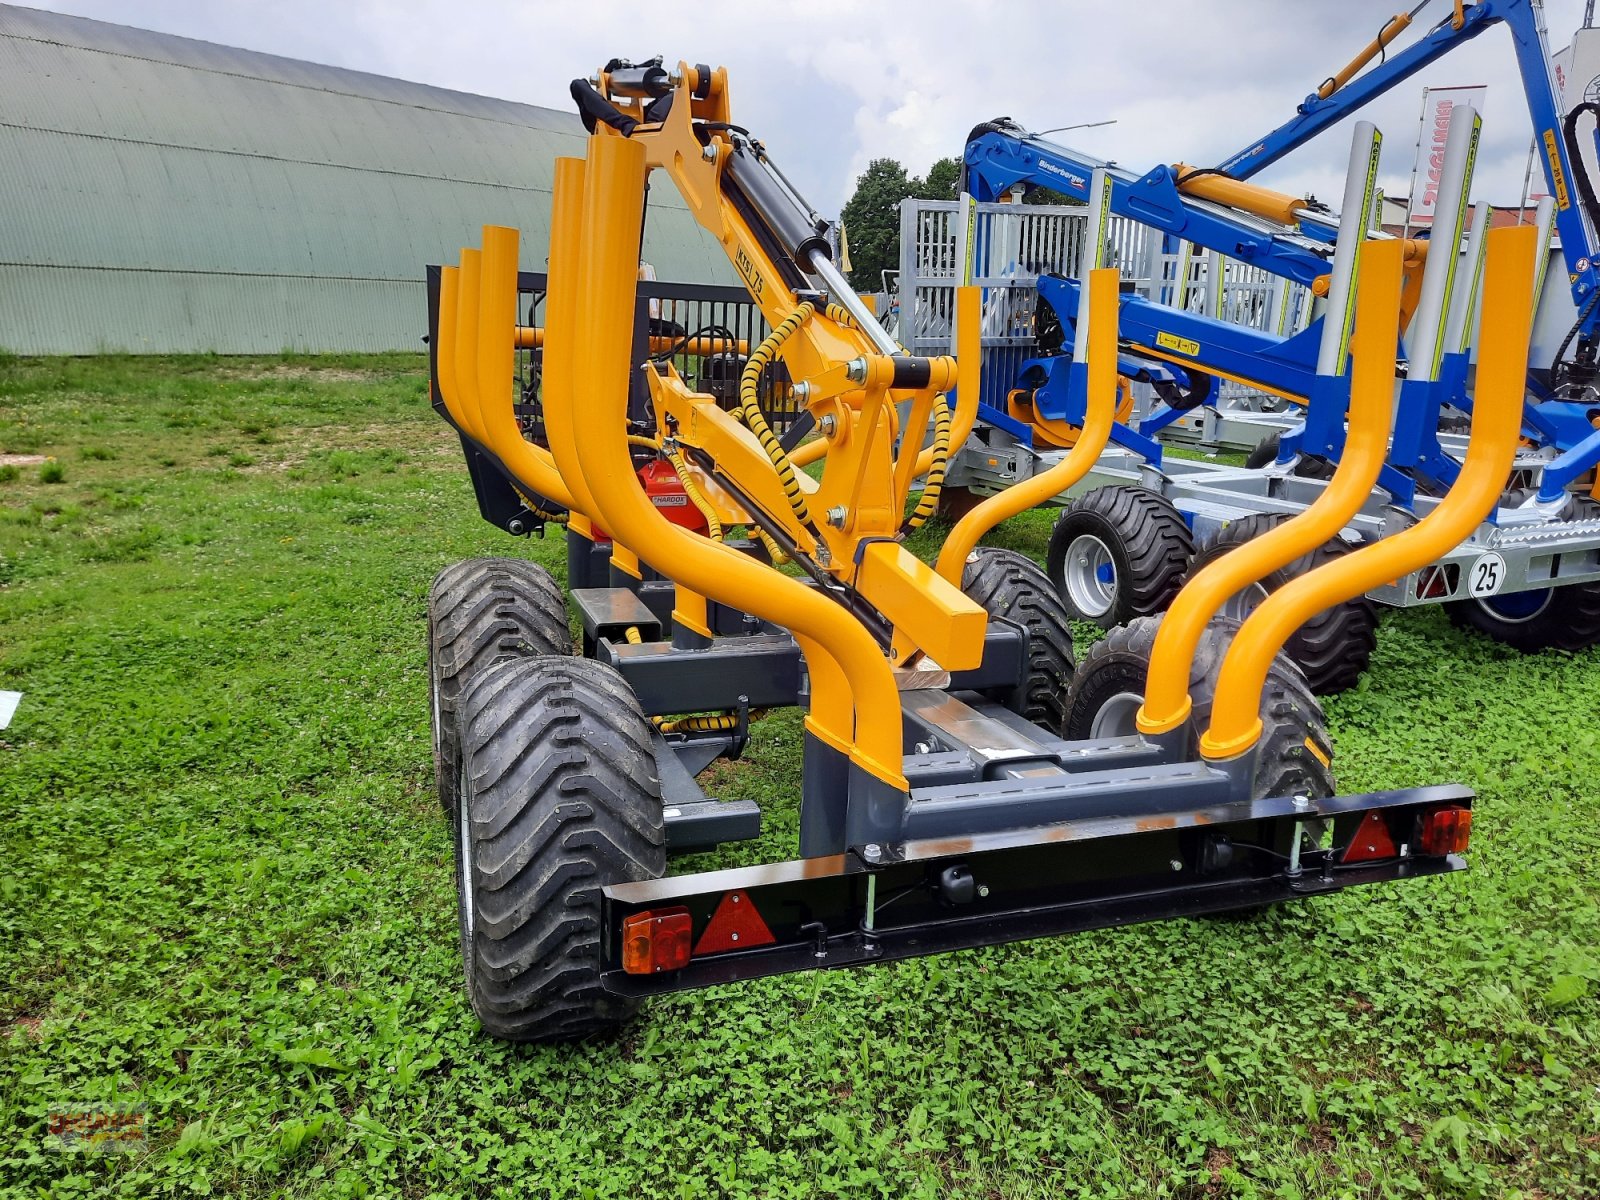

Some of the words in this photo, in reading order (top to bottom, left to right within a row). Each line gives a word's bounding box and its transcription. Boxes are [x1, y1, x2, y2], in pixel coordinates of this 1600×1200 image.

[1371, 141, 1380, 171] next
[1470, 127, 1480, 159] next
[1038, 159, 1086, 184] Binderberger
[753, 270, 764, 294] 75
[1475, 562, 1499, 592] 25
